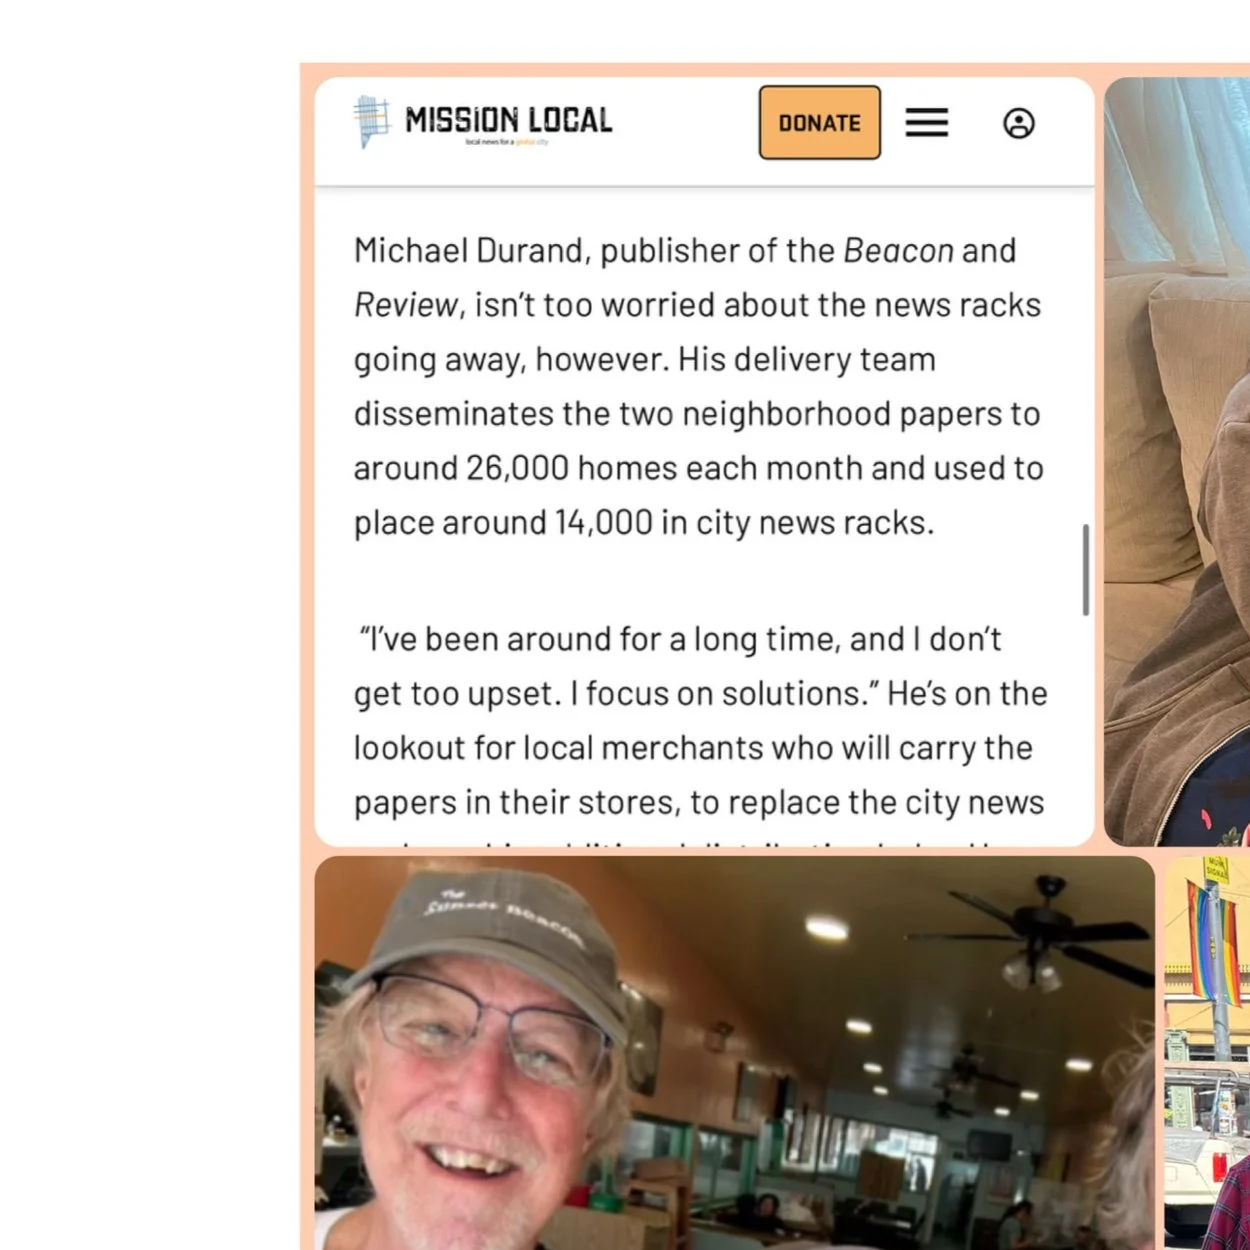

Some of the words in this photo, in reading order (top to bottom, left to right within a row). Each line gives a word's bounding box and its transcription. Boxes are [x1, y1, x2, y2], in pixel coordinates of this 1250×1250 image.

[779, 114, 861, 132] DONATE
[465, 138, 481, 146] local
[500, 138, 509, 146] for
[355, 236, 468, 264] Michael
[477, 236, 591, 266] Durand,
[601, 236, 741, 270] publisher
[748, 236, 778, 264] of
[786, 236, 835, 264] the
[844, 236, 954, 264] Beacon
[962, 236, 1016, 264] and
[354, 681, 402, 713] get
[410, 681, 459, 707] too
[468, 681, 561, 713] upset.
[572, 679, 577, 706] I
[586, 679, 669, 707] focus
[677, 686, 713, 707] on
[722, 679, 880, 707] solutions.”
[888, 679, 947, 707] He’s
[955, 686, 991, 706] on
[999, 679, 1048, 707] the
